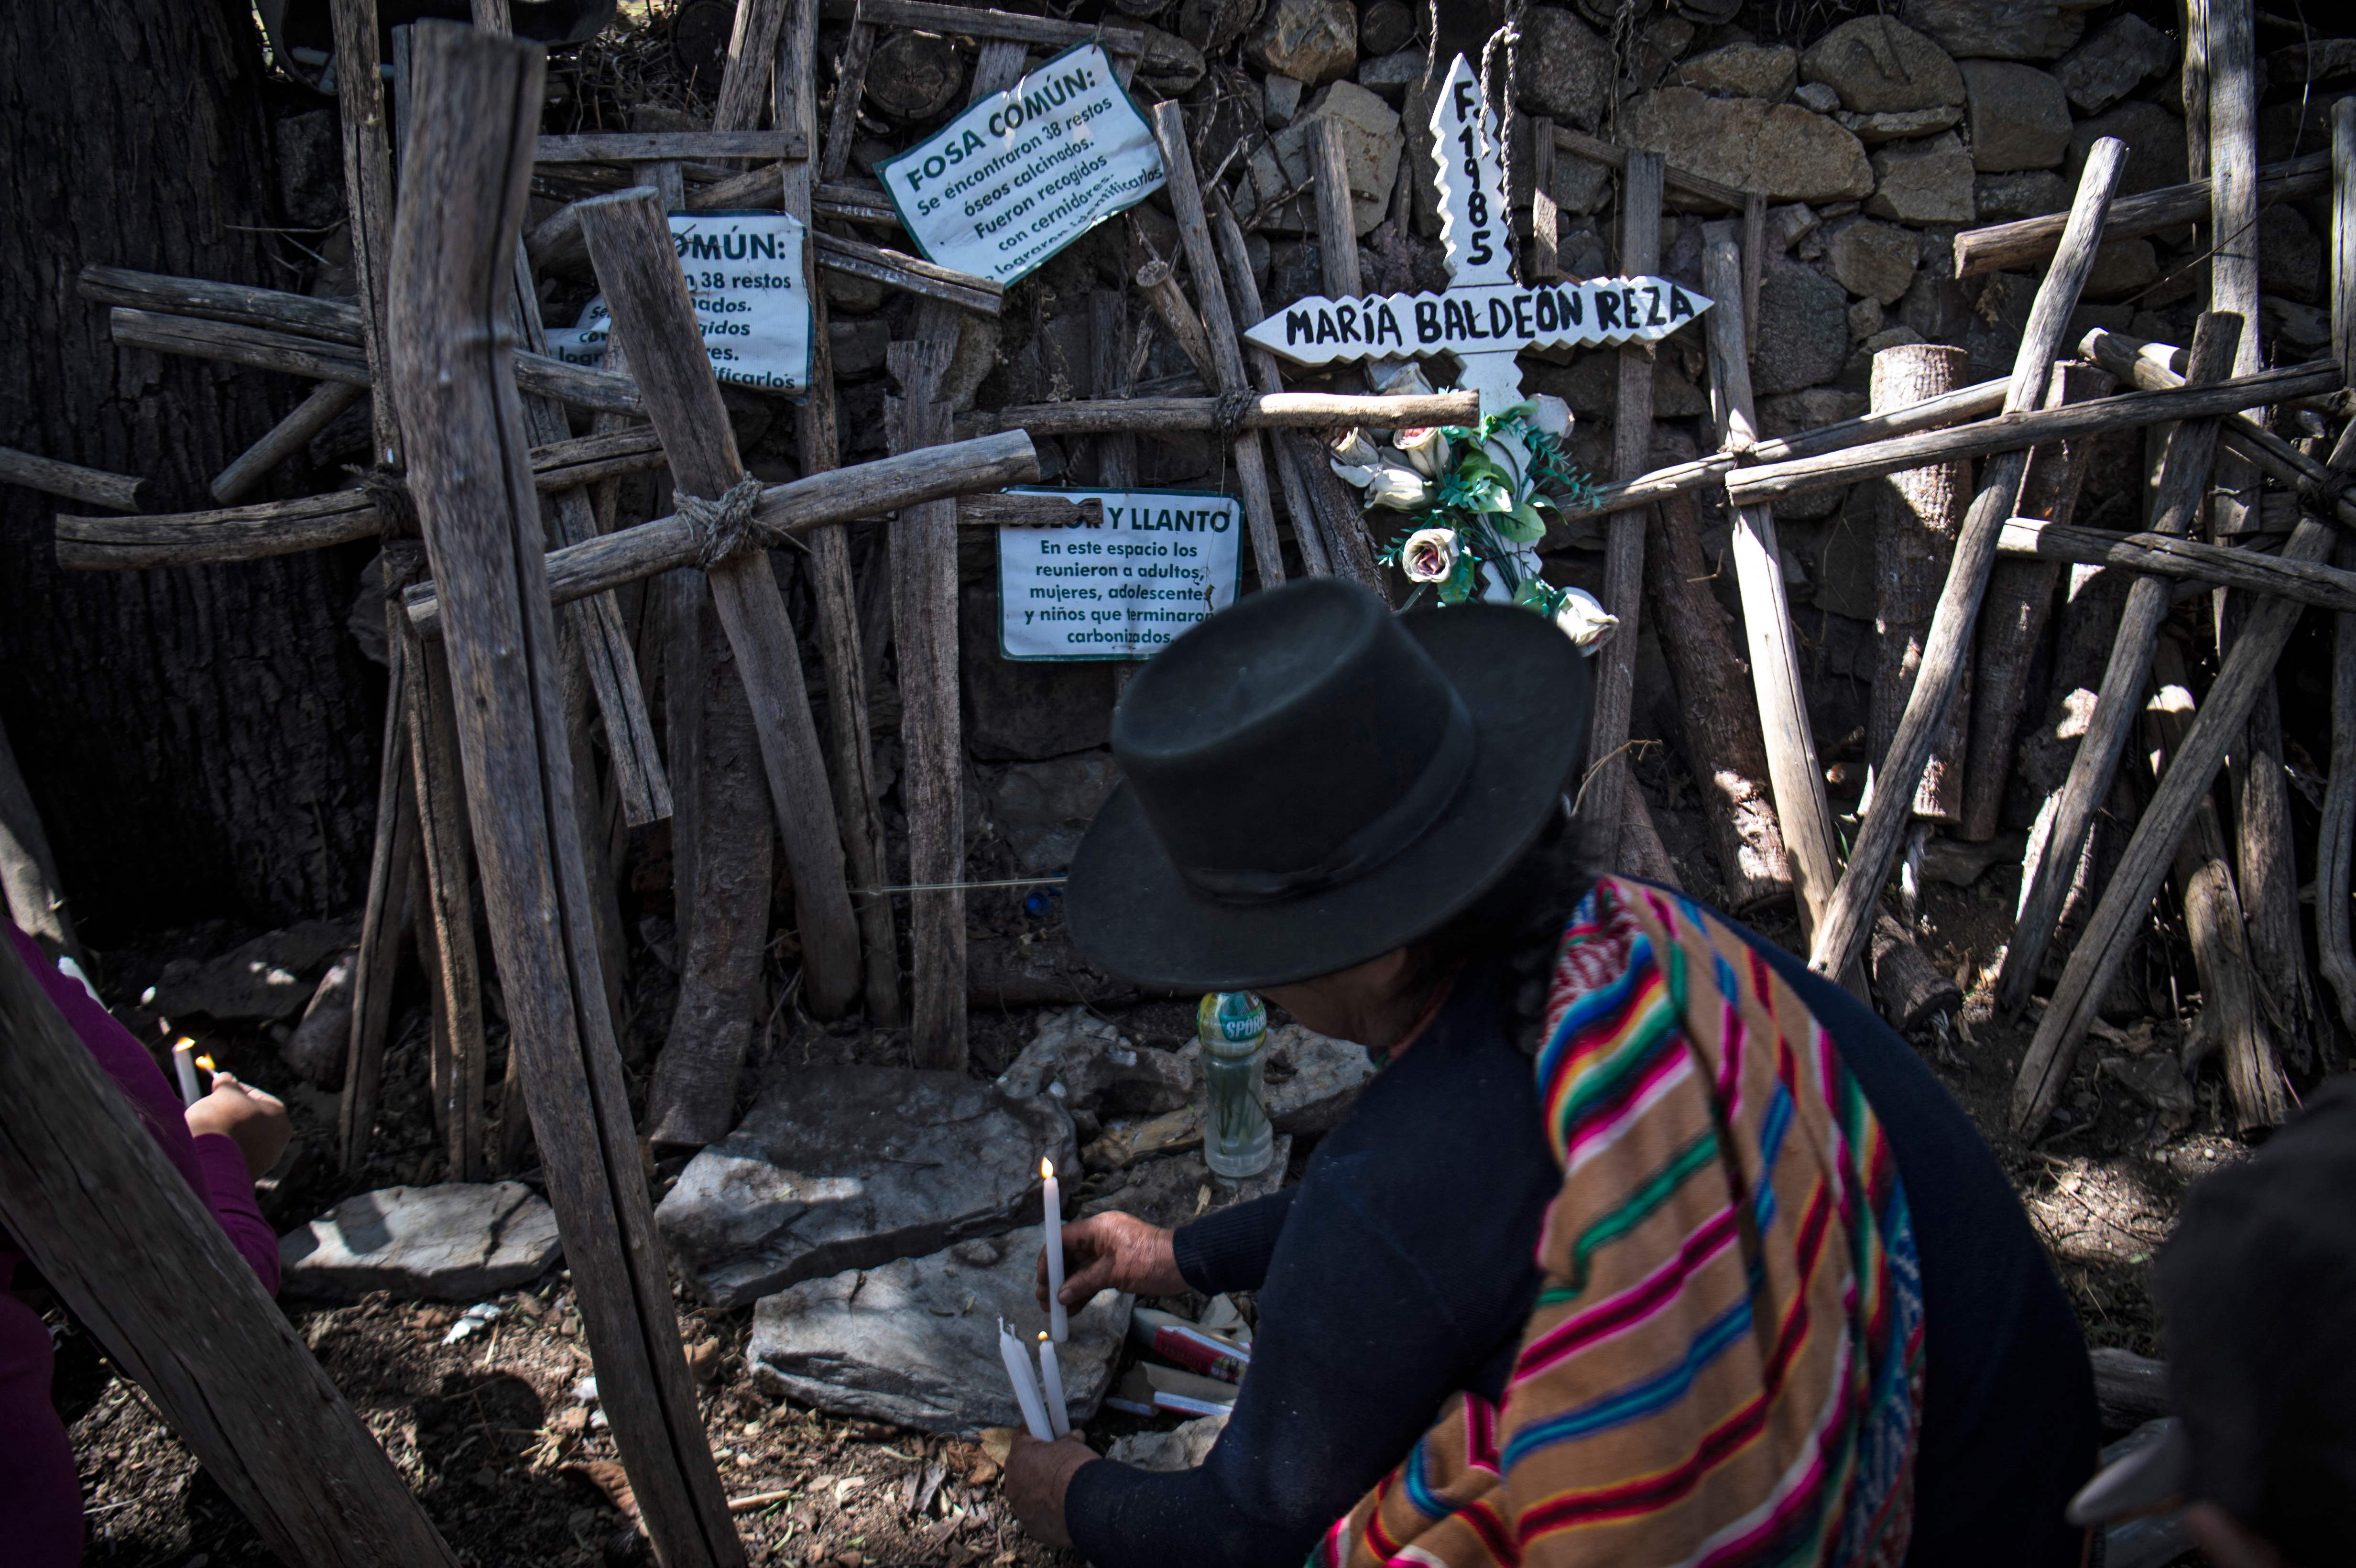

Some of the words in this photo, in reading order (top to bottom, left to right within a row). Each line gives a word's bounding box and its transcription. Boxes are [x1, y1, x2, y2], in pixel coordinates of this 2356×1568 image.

[1454, 80, 1481, 123] F.
[906, 130, 986, 193] FOSA
[989, 67, 1095, 137] COMÚN:
[917, 197, 940, 216] Se
[944, 136, 1042, 199] encontraron
[1042, 121, 1062, 140] 38
[1066, 98, 1112, 131] restos
[964, 183, 1010, 217] óseos
[1014, 139, 1094, 187] calcinados.
[974, 197, 1035, 239] Fueron
[1037, 155, 1107, 200] recogidos
[1458, 125, 1493, 266] 1985
[998, 231, 1028, 250] con
[1031, 174, 1114, 232] cernidores.
[672, 225, 785, 261] OMÚN:
[701, 272, 725, 289] 38
[732, 273, 791, 290] restos
[1286, 297, 1403, 348] MARÍA
[1415, 283, 1583, 344] BALDEÓN
[1594, 284, 1695, 332] REZA
[1107, 507, 1124, 530] Y
[1131, 508, 1230, 533] LLANTO
[1040, 540, 1061, 554] En
[1067, 541, 1102, 555] este
[1107, 541, 1168, 559] espacio
[1174, 542, 1197, 557] los
[1036, 562, 1118, 577] reunieron
[1123, 567, 1133, 577] a
[1138, 563, 1204, 581] adultos,
[1030, 584, 1102, 602] mujeres,
[1025, 610, 1035, 625] y
[1040, 606, 1086, 621] niños
[1091, 610, 1122, 625] que
[1067, 628, 1175, 644] carbonizados.
